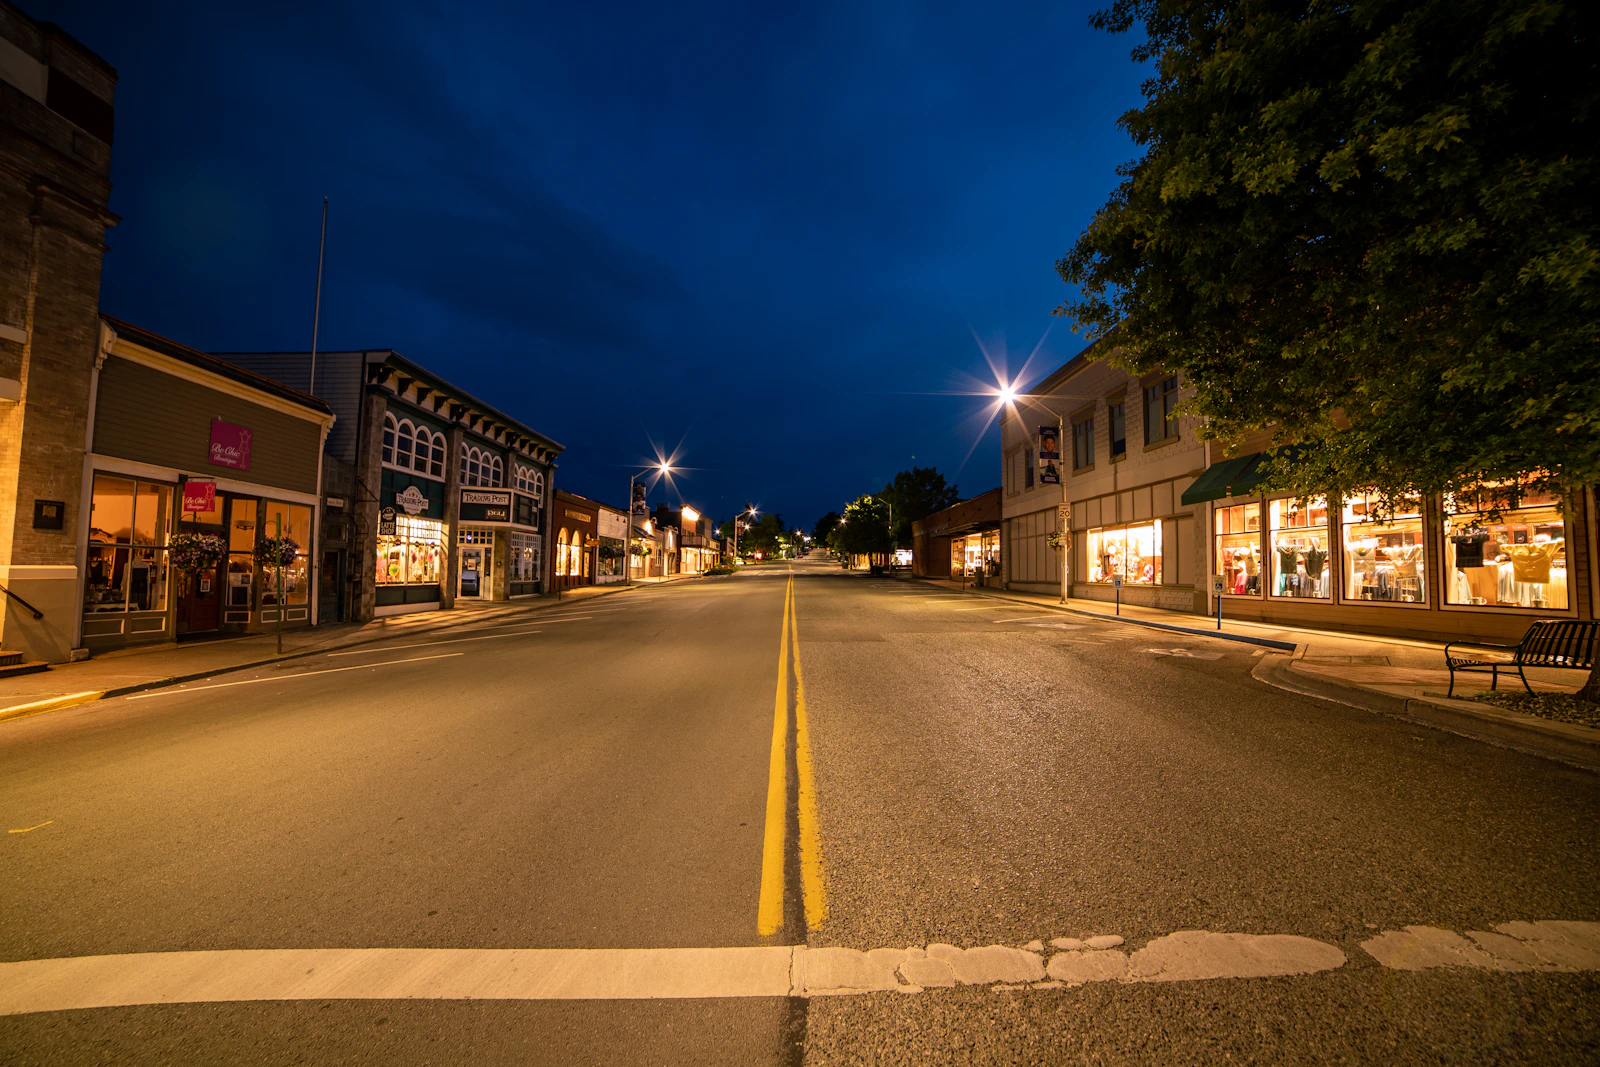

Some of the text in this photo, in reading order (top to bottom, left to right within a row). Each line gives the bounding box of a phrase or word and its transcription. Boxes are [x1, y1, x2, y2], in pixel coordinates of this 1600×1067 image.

[212, 443, 240, 457] Be Chic
[213, 454, 237, 464] Boutique
[465, 493, 491, 502] TRADING
[1059, 510, 1070, 518] 20
[381, 521, 395, 529] LATTE
